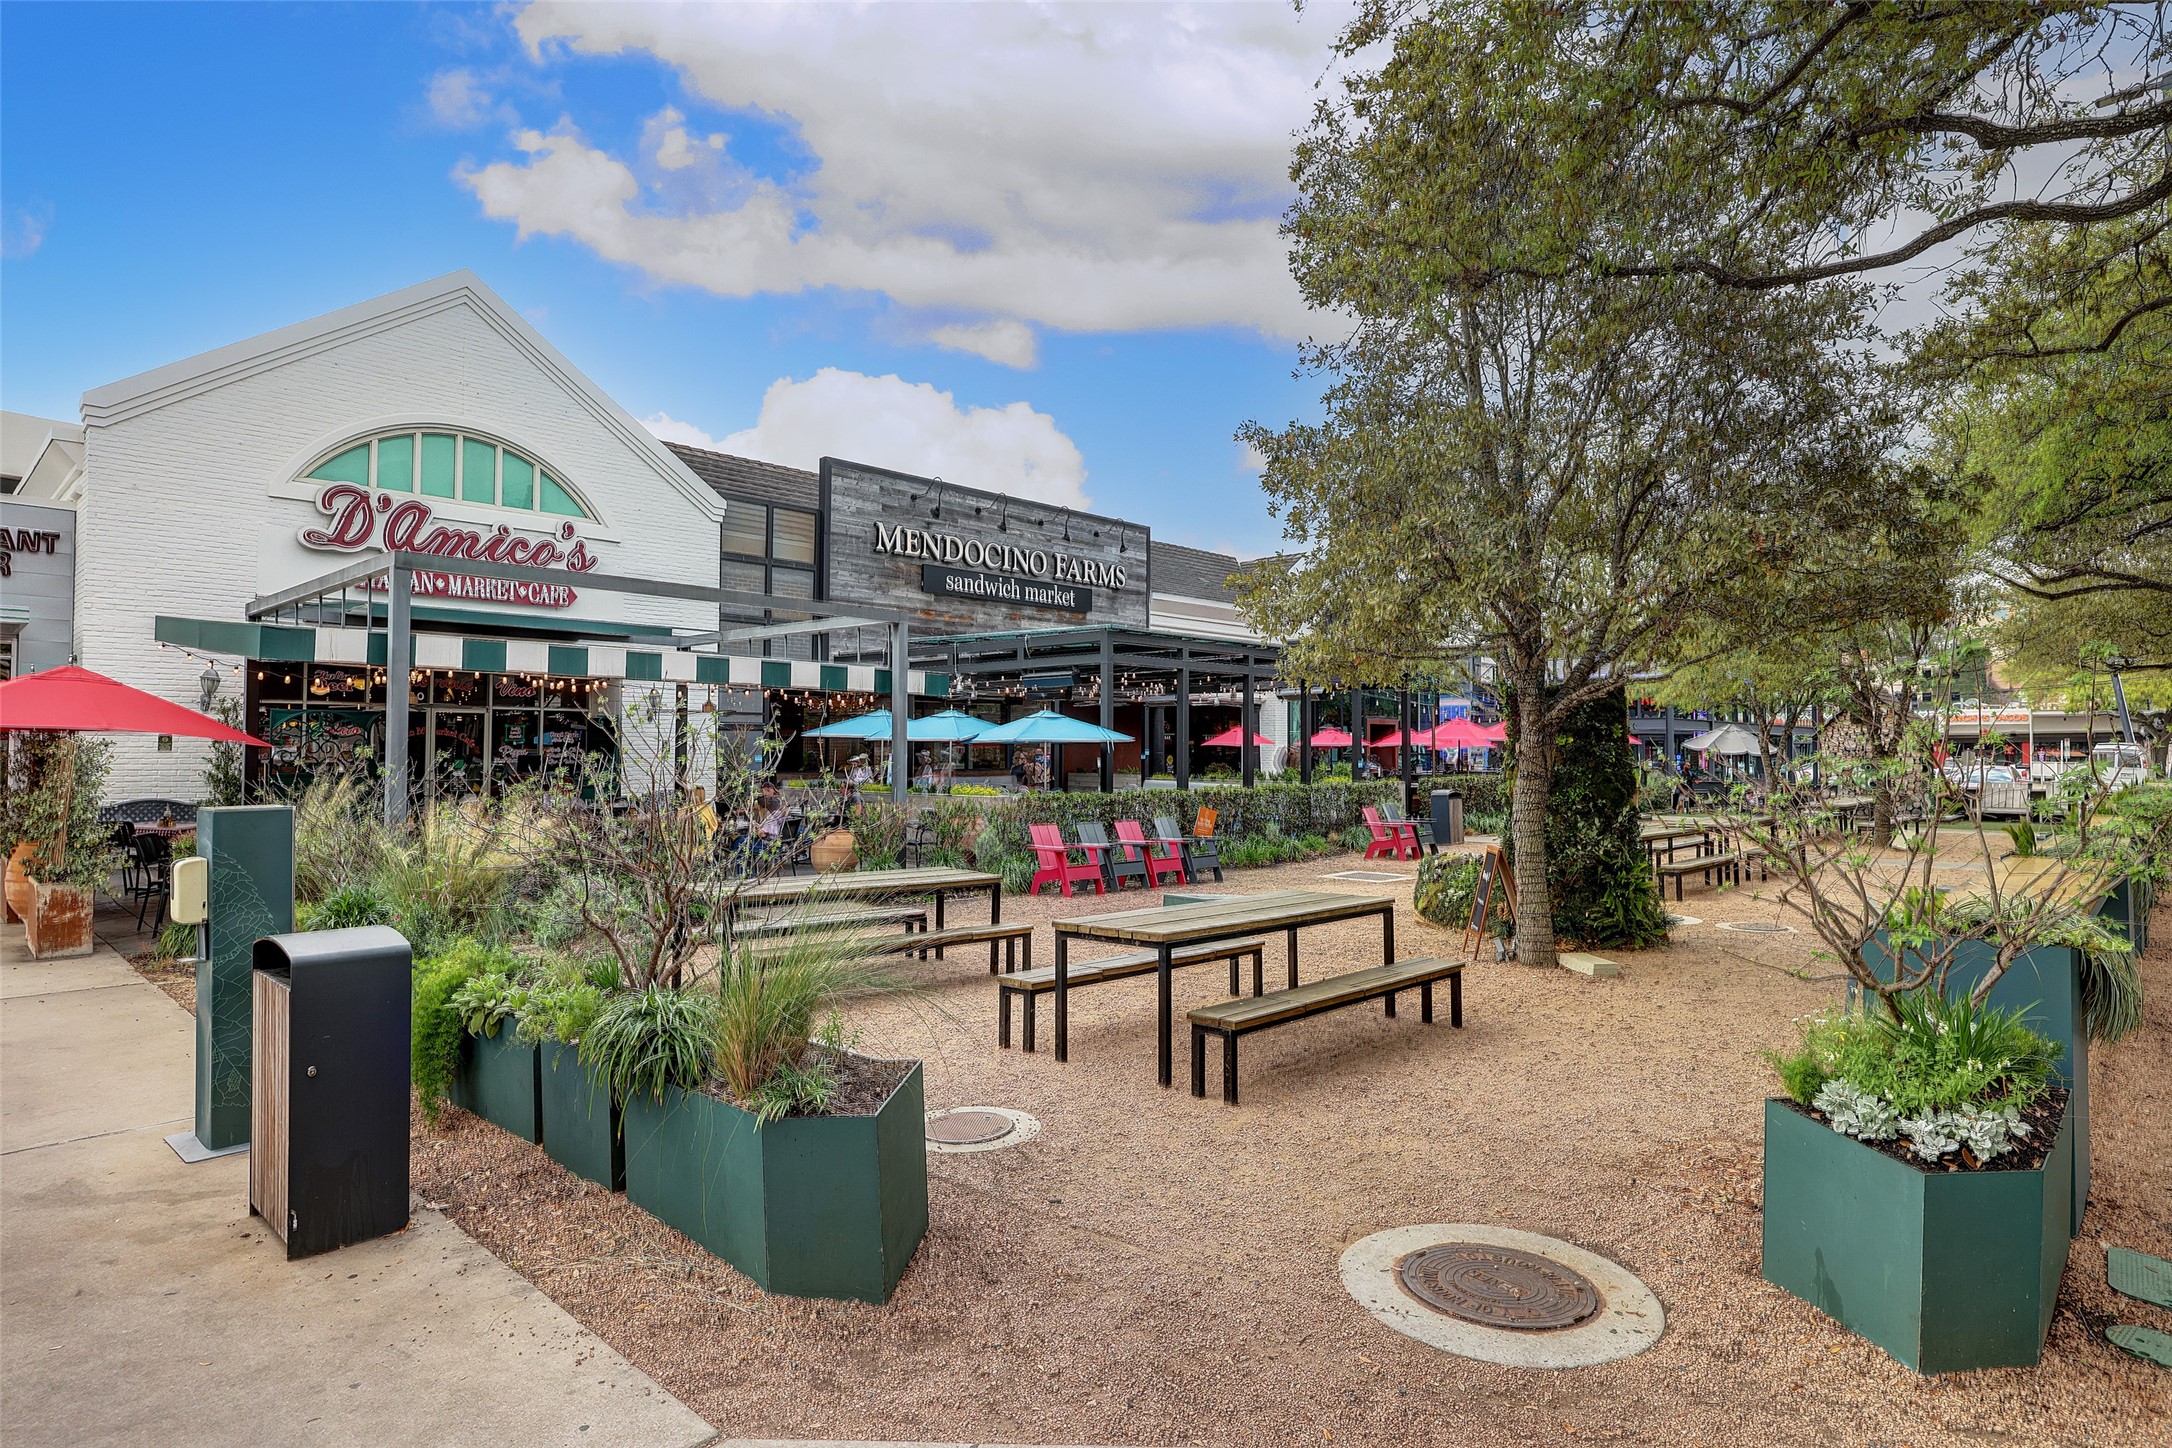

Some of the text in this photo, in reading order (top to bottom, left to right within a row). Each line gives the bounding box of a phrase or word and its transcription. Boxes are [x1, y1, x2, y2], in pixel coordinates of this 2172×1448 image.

[303, 484, 598, 573] D'Amico's
[874, 521, 1127, 590] MENDOCINO FARMS
[448, 574, 519, 602] MARKET
[528, 583, 570, 608] CAFE
[945, 574, 1076, 608] sandwich market
[495, 681, 536, 697] Vino
